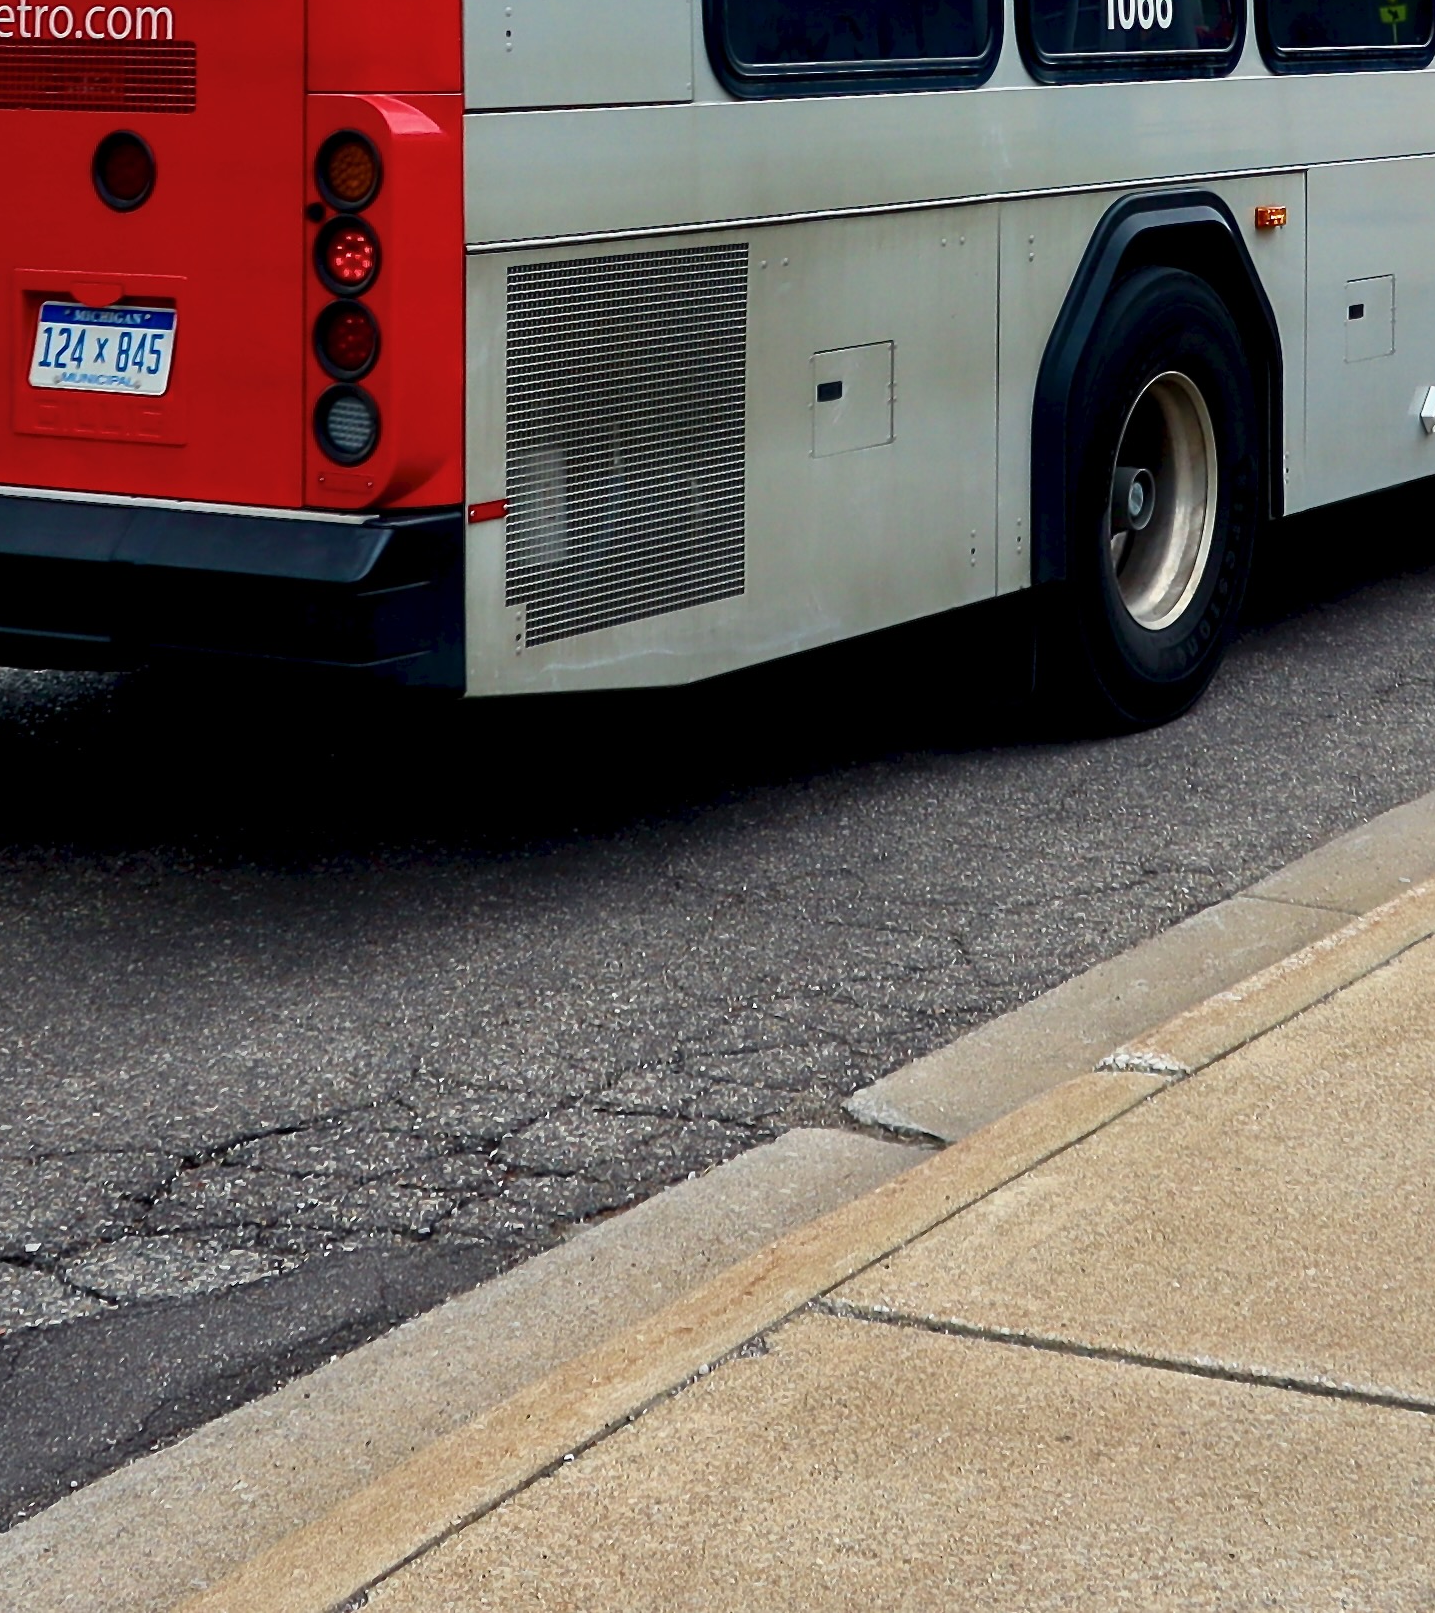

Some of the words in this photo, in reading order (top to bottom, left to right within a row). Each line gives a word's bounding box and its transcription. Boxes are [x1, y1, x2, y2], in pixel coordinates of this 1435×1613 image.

[72, 309, 143, 325] MICHIGAN
[38, 327, 87, 370] 124
[115, 331, 165, 375] 845
[60, 371, 134, 387] MUNICIPAL
